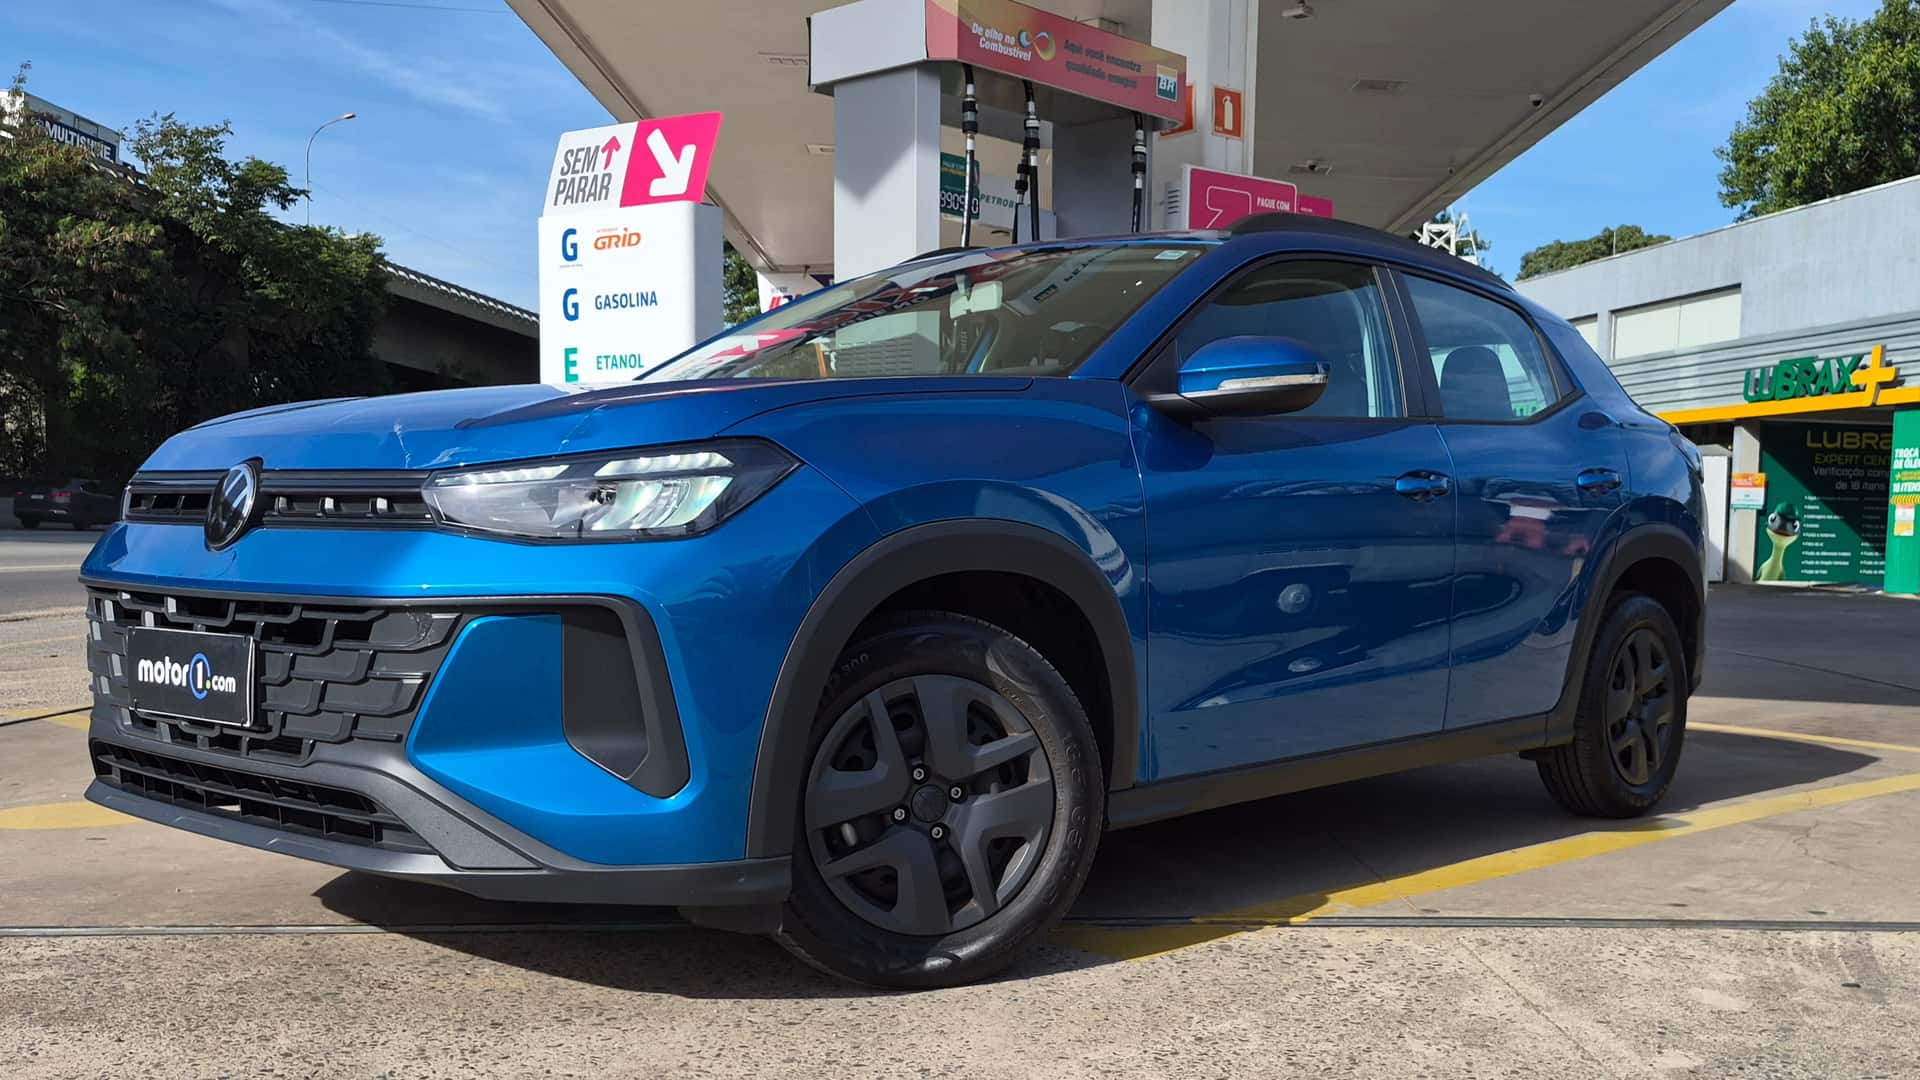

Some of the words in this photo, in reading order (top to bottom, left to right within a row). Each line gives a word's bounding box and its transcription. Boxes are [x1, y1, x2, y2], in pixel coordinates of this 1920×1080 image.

[1004, 34, 1016, 46] no
[1159, 76, 1176, 94] BR
[45, 120, 113, 163] MULTISHE
[560, 145, 600, 176] SEM
[553, 172, 612, 206] PARAR
[1276, 200, 1290, 211] COM
[561, 228, 578, 262] G
[562, 288, 579, 322] G
[594, 291, 658, 311] GASOLINA
[564, 347, 579, 384] E
[596, 353, 645, 371] ETANOL
[1807, 431, 1892, 449] LUBRA
[138, 654, 236, 697] motor1.com
